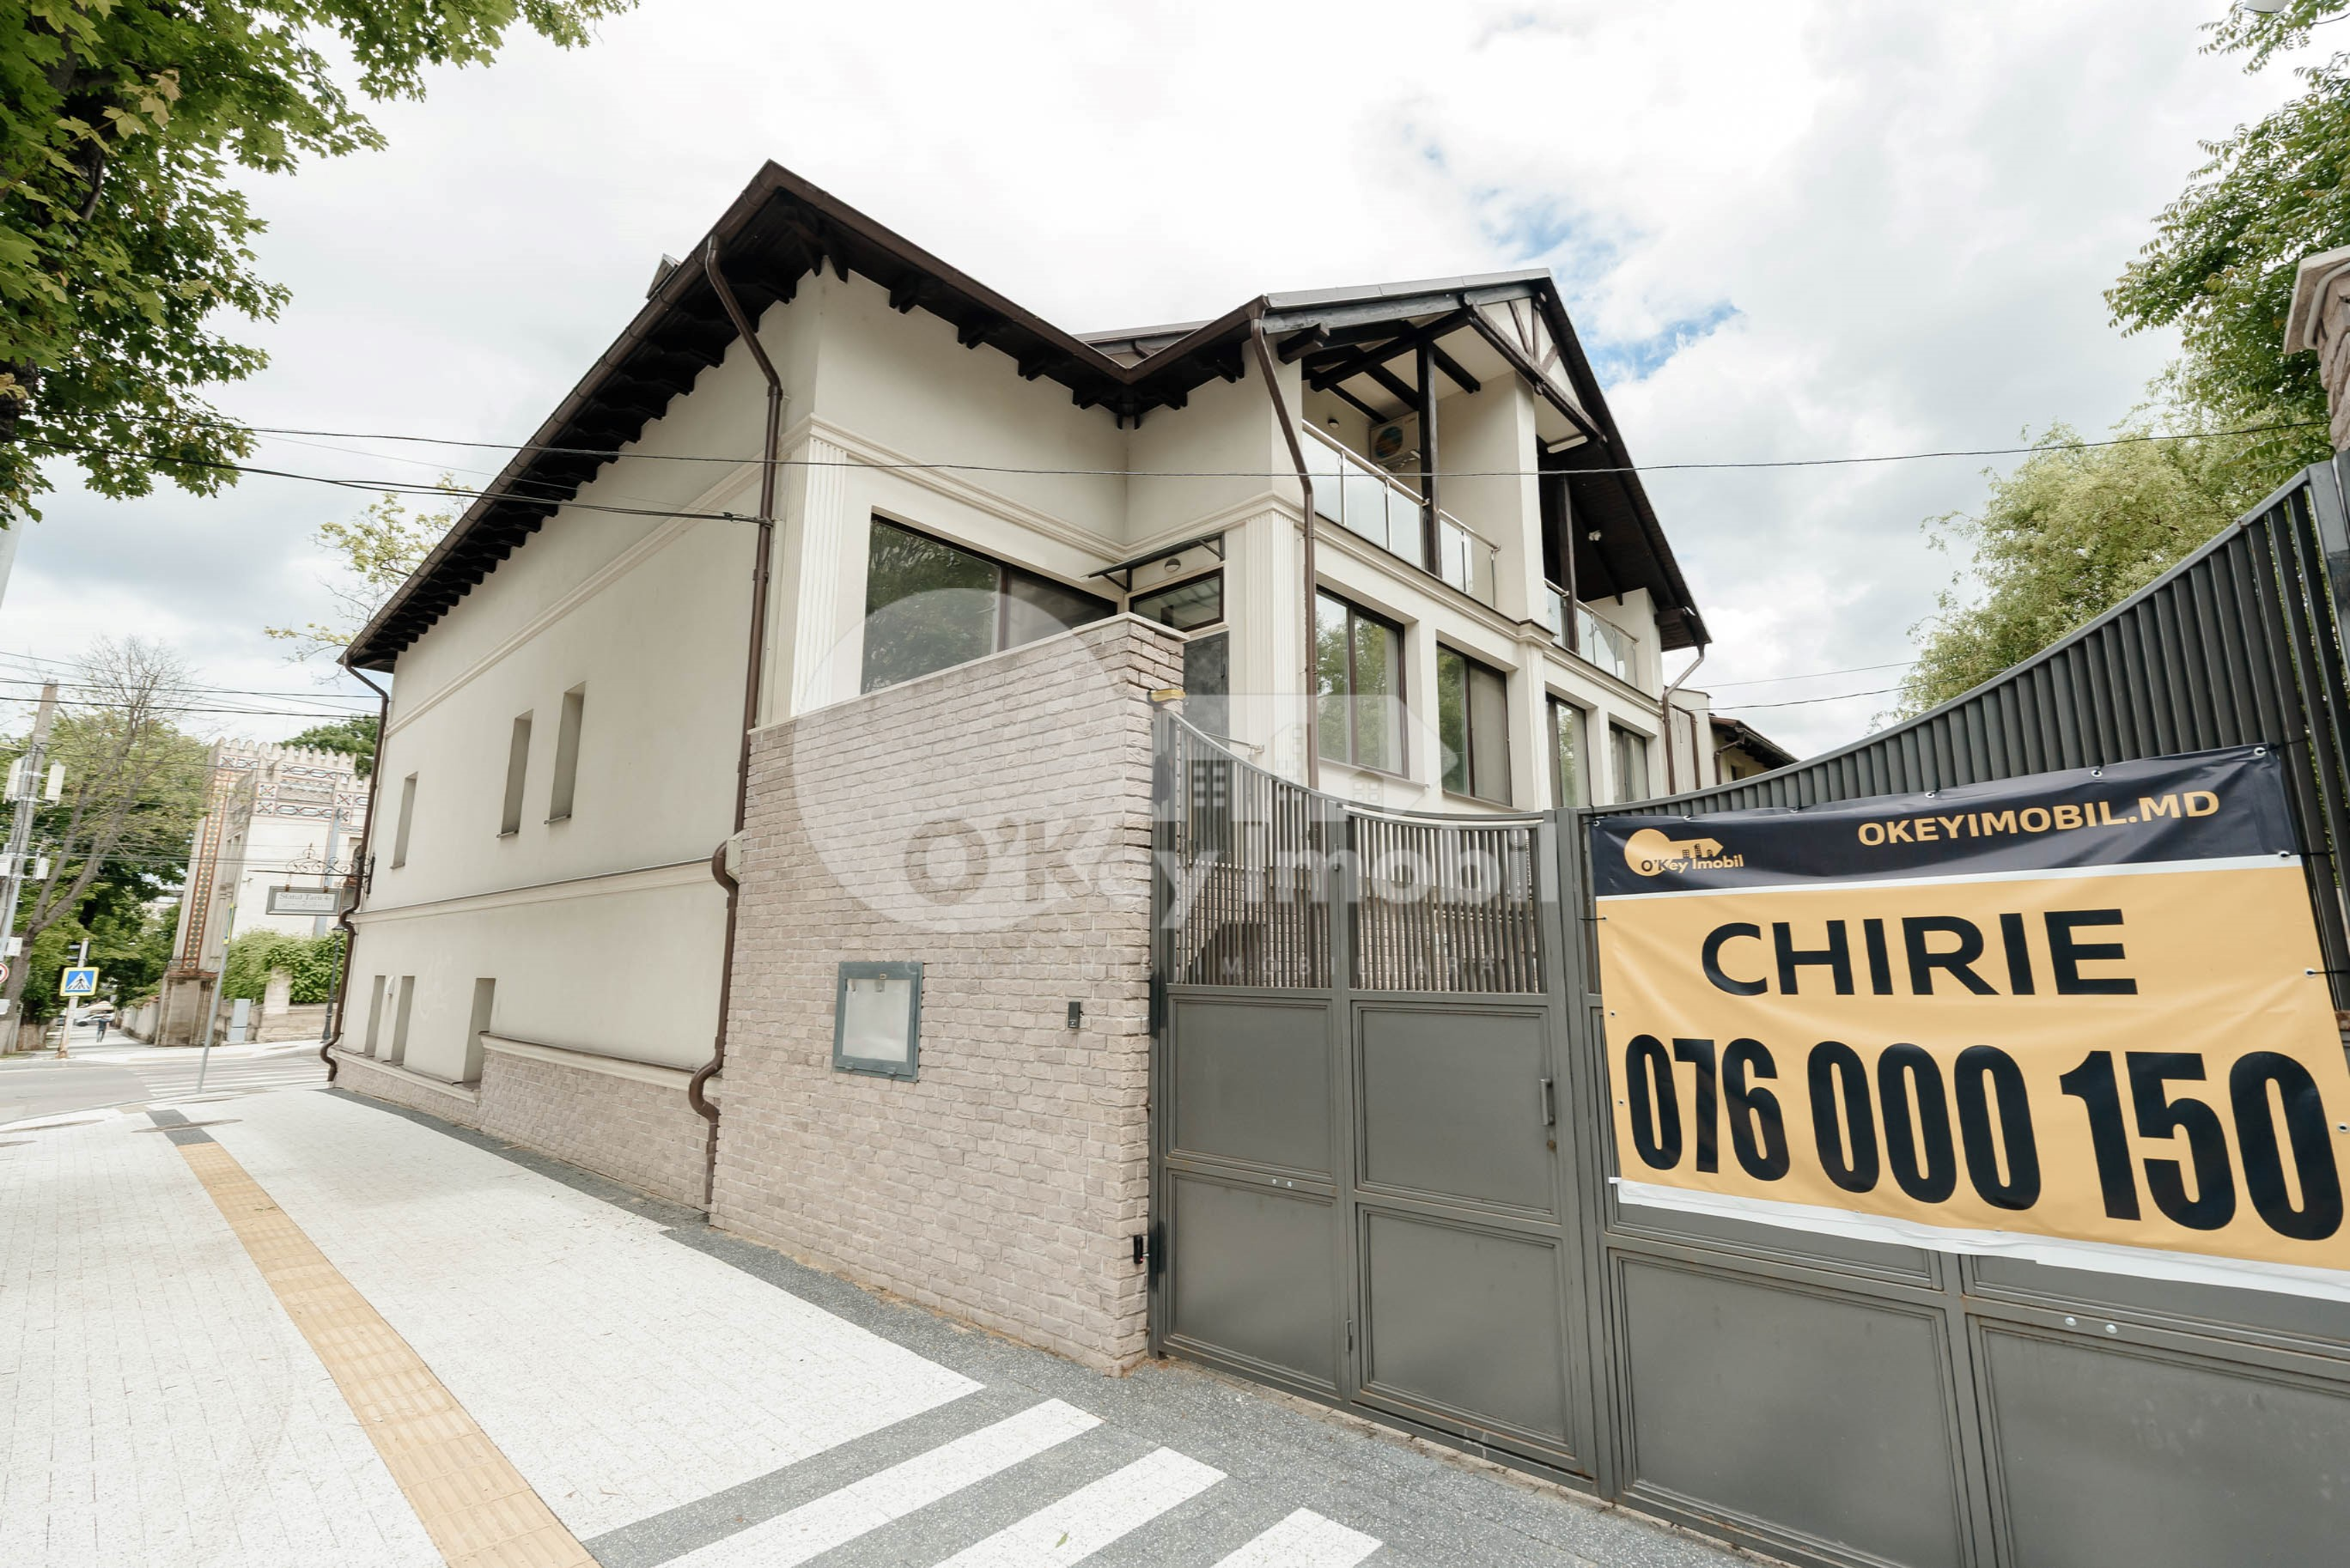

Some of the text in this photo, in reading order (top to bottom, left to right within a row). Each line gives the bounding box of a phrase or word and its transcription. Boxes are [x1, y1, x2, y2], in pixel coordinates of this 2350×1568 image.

[1858, 791, 2220, 846] OKEYIMOBIL.MD
[1641, 854, 1745, 874] O'Key Imobil
[1701, 908, 2139, 997] CHIRIE
[1625, 1034, 2345, 1242] 076 000 150
